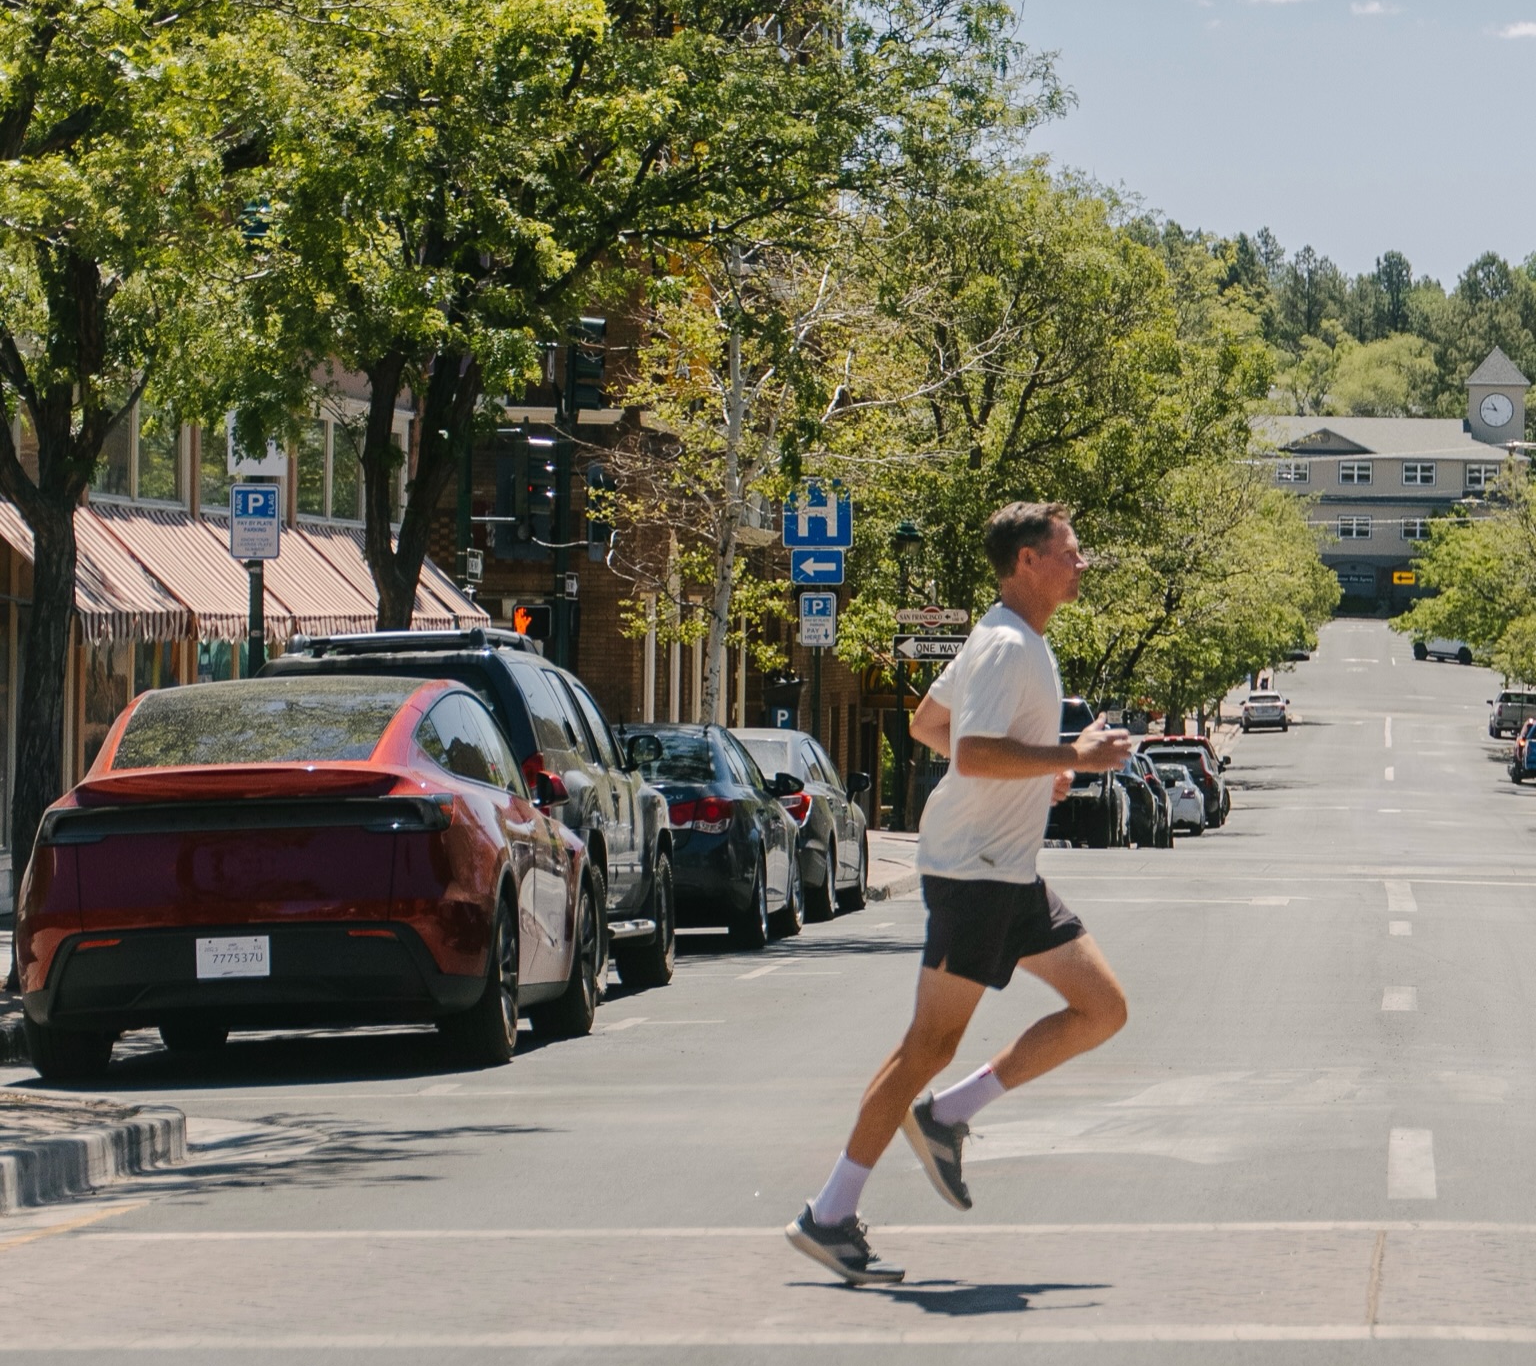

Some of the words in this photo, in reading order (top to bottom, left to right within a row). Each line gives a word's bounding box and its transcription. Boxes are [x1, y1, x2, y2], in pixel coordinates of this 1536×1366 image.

[248, 493, 264, 514] P
[798, 488, 838, 537] H
[812, 600, 823, 614] P
[916, 644, 935, 652] ONE
[940, 644, 960, 652] WAY
[777, 709, 789, 727] P
